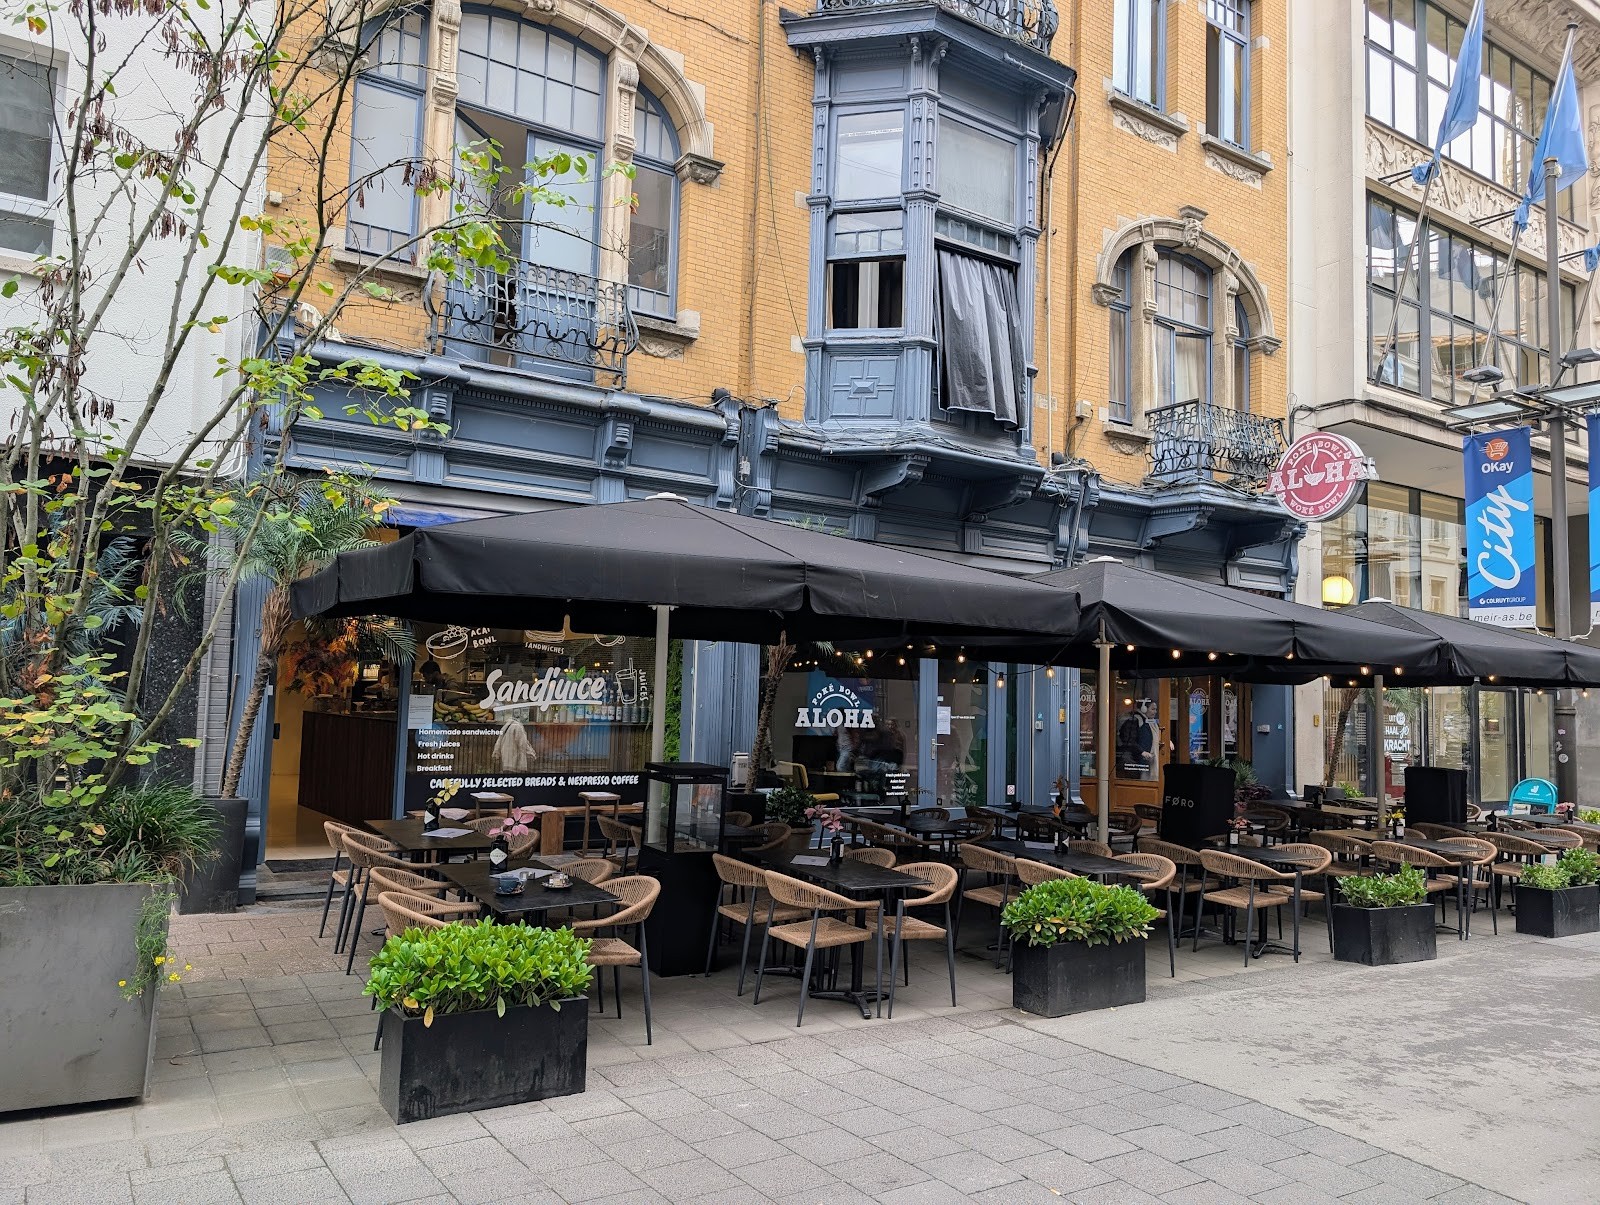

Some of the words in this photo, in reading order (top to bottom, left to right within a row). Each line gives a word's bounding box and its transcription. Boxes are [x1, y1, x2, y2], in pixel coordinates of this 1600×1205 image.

[1288, 442, 1312, 465] POKÉ
[1482, 461, 1513, 474] OKay
[1289, 499, 1314, 515] WOKÉ
[1318, 492, 1343, 512] BOWL
[1477, 485, 1529, 590] City
[1474, 612, 1532, 622] meir-as.be
[473, 636, 497, 648] BOWL
[480, 666, 606, 712] Sandjuice
[812, 683, 834, 705] POKÉ
[839, 685, 861, 708] BOWL
[795, 707, 876, 728] ALOHA
[1385, 726, 1399, 735] HAAL
[439, 740, 460, 748] juices
[1384, 739, 1410, 751] KRACHT
[482, 777, 523, 788] SELECTED
[525, 776, 556, 787] BREADS
[558, 776, 565, 786] &
[568, 775, 610, 786] NESPRESSO
[611, 775, 639, 785] COFFEE
